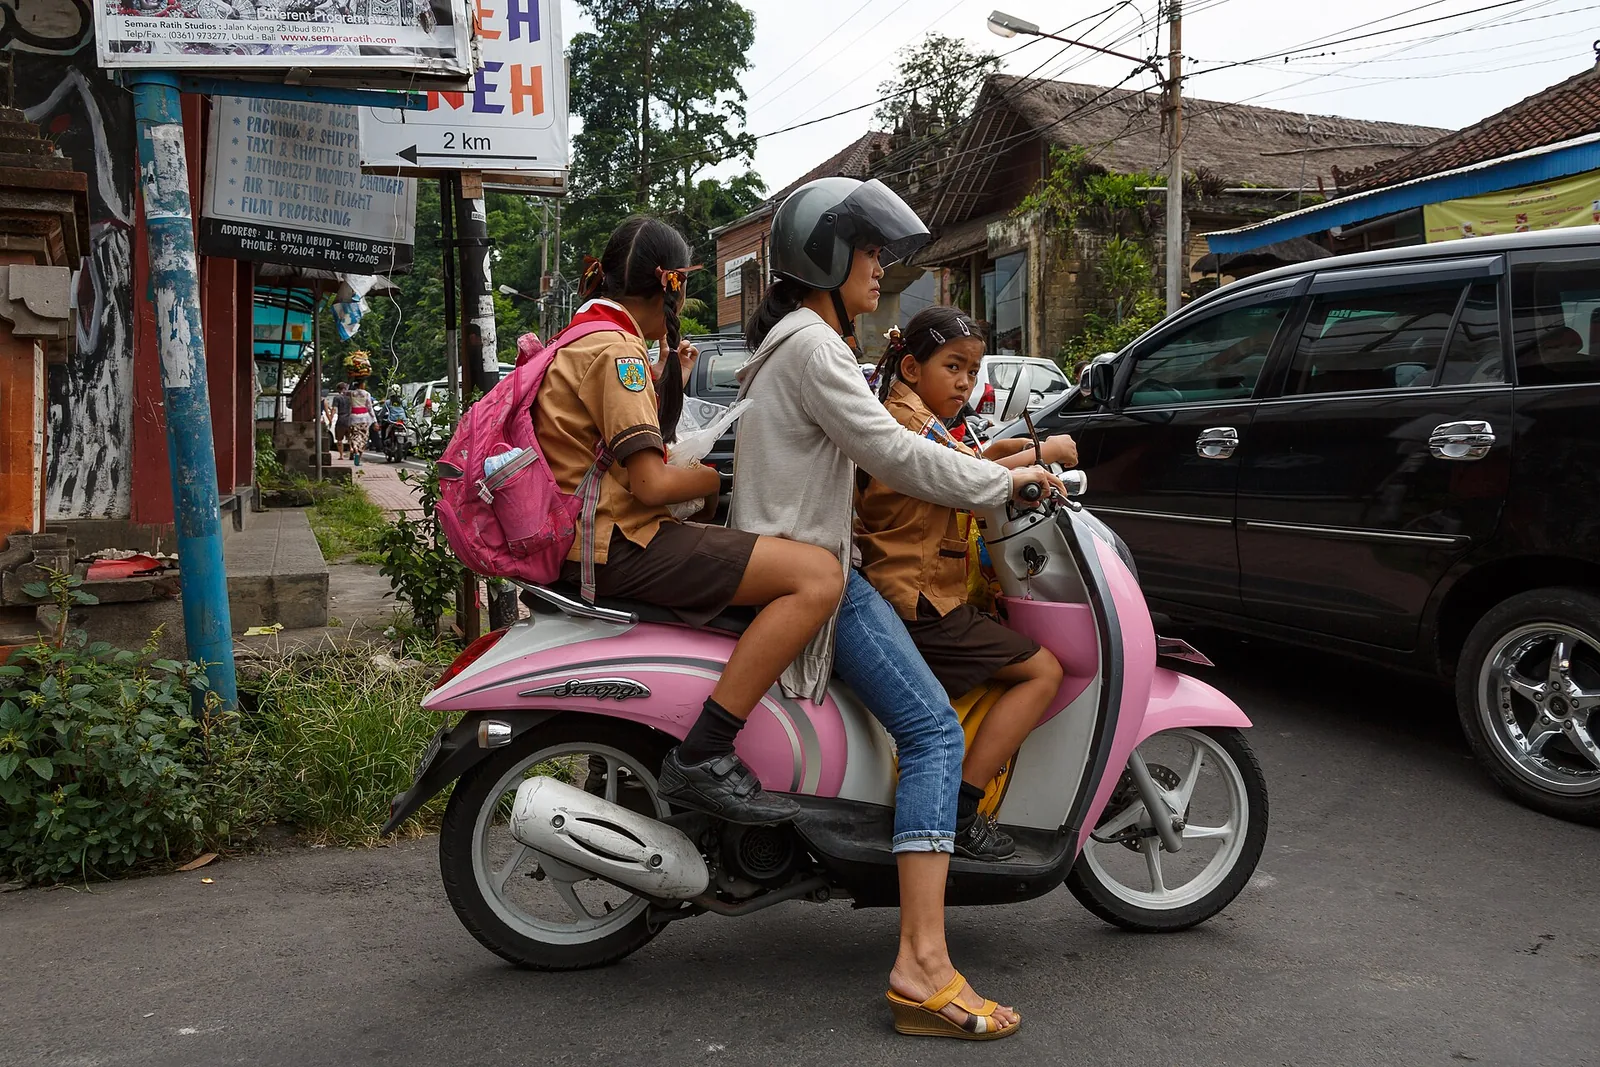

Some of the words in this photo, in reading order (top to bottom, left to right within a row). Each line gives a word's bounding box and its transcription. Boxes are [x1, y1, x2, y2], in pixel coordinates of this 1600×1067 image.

[124, 20, 157, 29] Semara
[160, 21, 183, 30] Ratih
[185, 22, 217, 30] Studios
[224, 23, 245, 31] Jalan
[247, 24, 274, 33] Kajeng
[288, 25, 310, 33] Ubud
[257, 7, 312, 21] Different
[315, 10, 368, 25] Program
[125, 30, 167, 39] Telp/Fax.:
[168, 31, 195, 40] (0361)
[197, 32, 230, 41] 973277,
[232, 33, 254, 41] Ubud
[261, 33, 276, 41] Bali
[281, 34, 397, 44] www.semararatih.com
[248, 98, 322, 123] INSURANCE
[247, 116, 301, 139] PACKING
[308, 127, 315, 141] &
[443, 132, 455, 149] 2
[462, 132, 491, 150] km
[247, 135, 273, 155] TAXI
[279, 144, 287, 157] &
[292, 145, 345, 167] SHUTTLE
[245, 156, 312, 180] AUTHORIZED
[316, 167, 356, 188] MONEY
[360, 175, 404, 195] CHANGER
[243, 176, 262, 194] AIR
[268, 179, 329, 204] TICKETING
[335, 190, 373, 210] FLIGHT
[241, 196, 273, 216] FILM
[279, 202, 351, 227] PROCESSING
[221, 224, 260, 237] ADDRESS:
[265, 230, 278, 241] JL.
[280, 232, 303, 244] RAYA
[306, 235, 332, 247] UBUD
[343, 240, 368, 252] UBUD
[241, 238, 277, 251] PHONE:
[281, 244, 315, 257] 976104
[324, 249, 345, 260] FAX:
[348, 252, 379, 265] 976005
[554, 679, 644, 701] Scoopy
